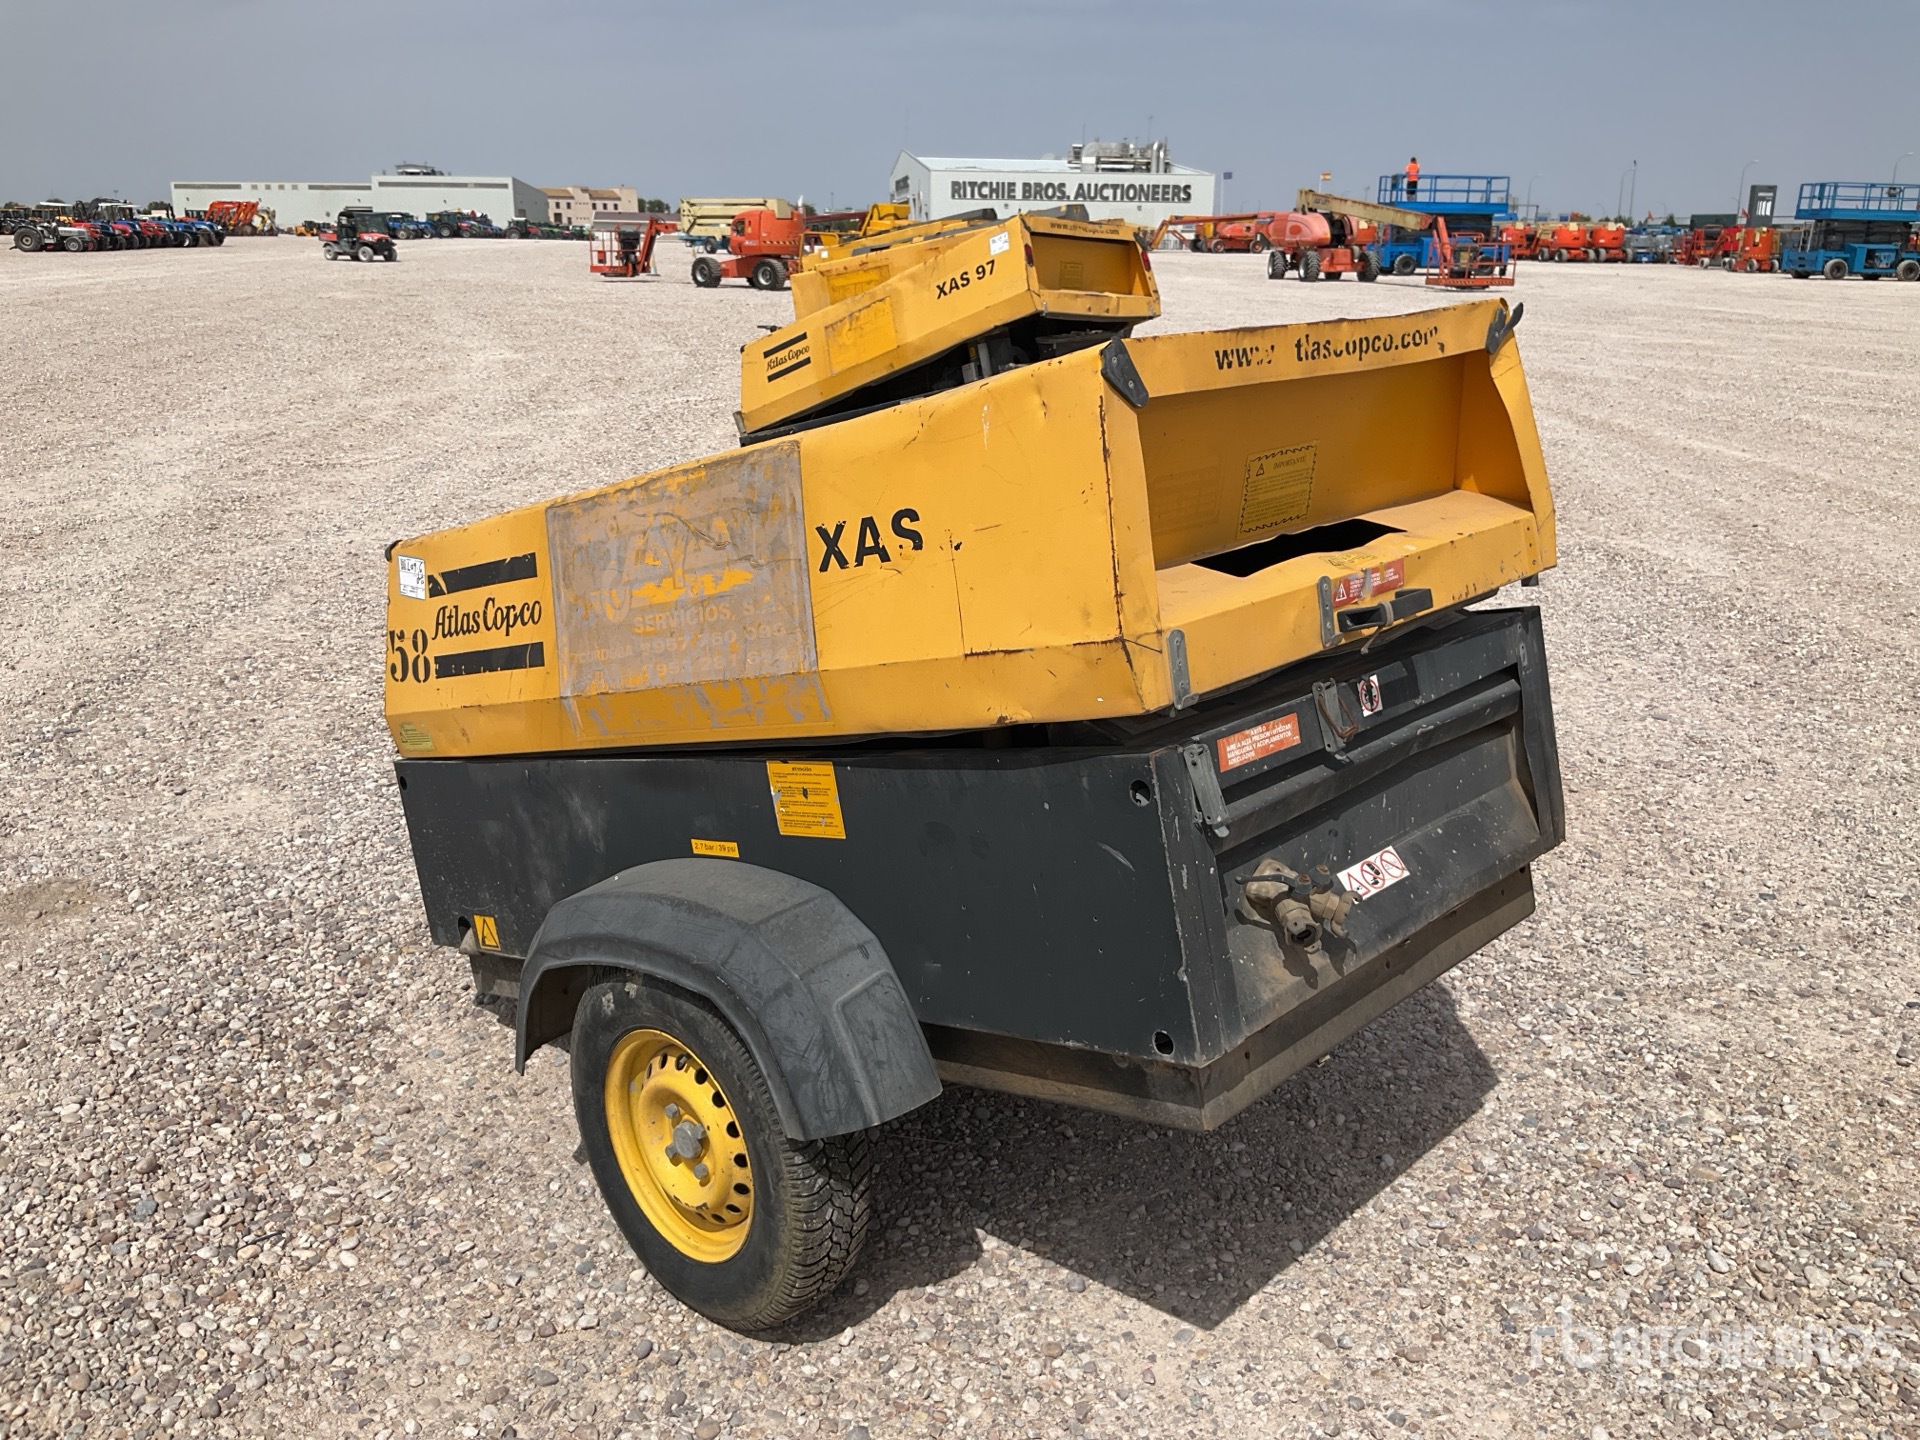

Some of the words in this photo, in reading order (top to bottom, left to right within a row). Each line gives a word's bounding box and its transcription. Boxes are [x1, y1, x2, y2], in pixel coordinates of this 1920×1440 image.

[951, 181, 1017, 199] RITCHIE
[1021, 182, 1070, 200] BROS.
[1074, 183, 1192, 202] AUCTIONEERS
[936, 271, 971, 299] XAS
[975, 259, 995, 280] 97
[766, 357, 788, 371] Atlas
[788, 346, 810, 359] Copco
[815, 507, 924, 573] XAS
[432, 604, 480, 640] Atlas
[483, 597, 542, 636] Copco
[389, 629, 431, 684] 58
[694, 842, 704, 850] 2.7
[704, 843, 714, 851] bar
[718, 844, 727, 852] 39
